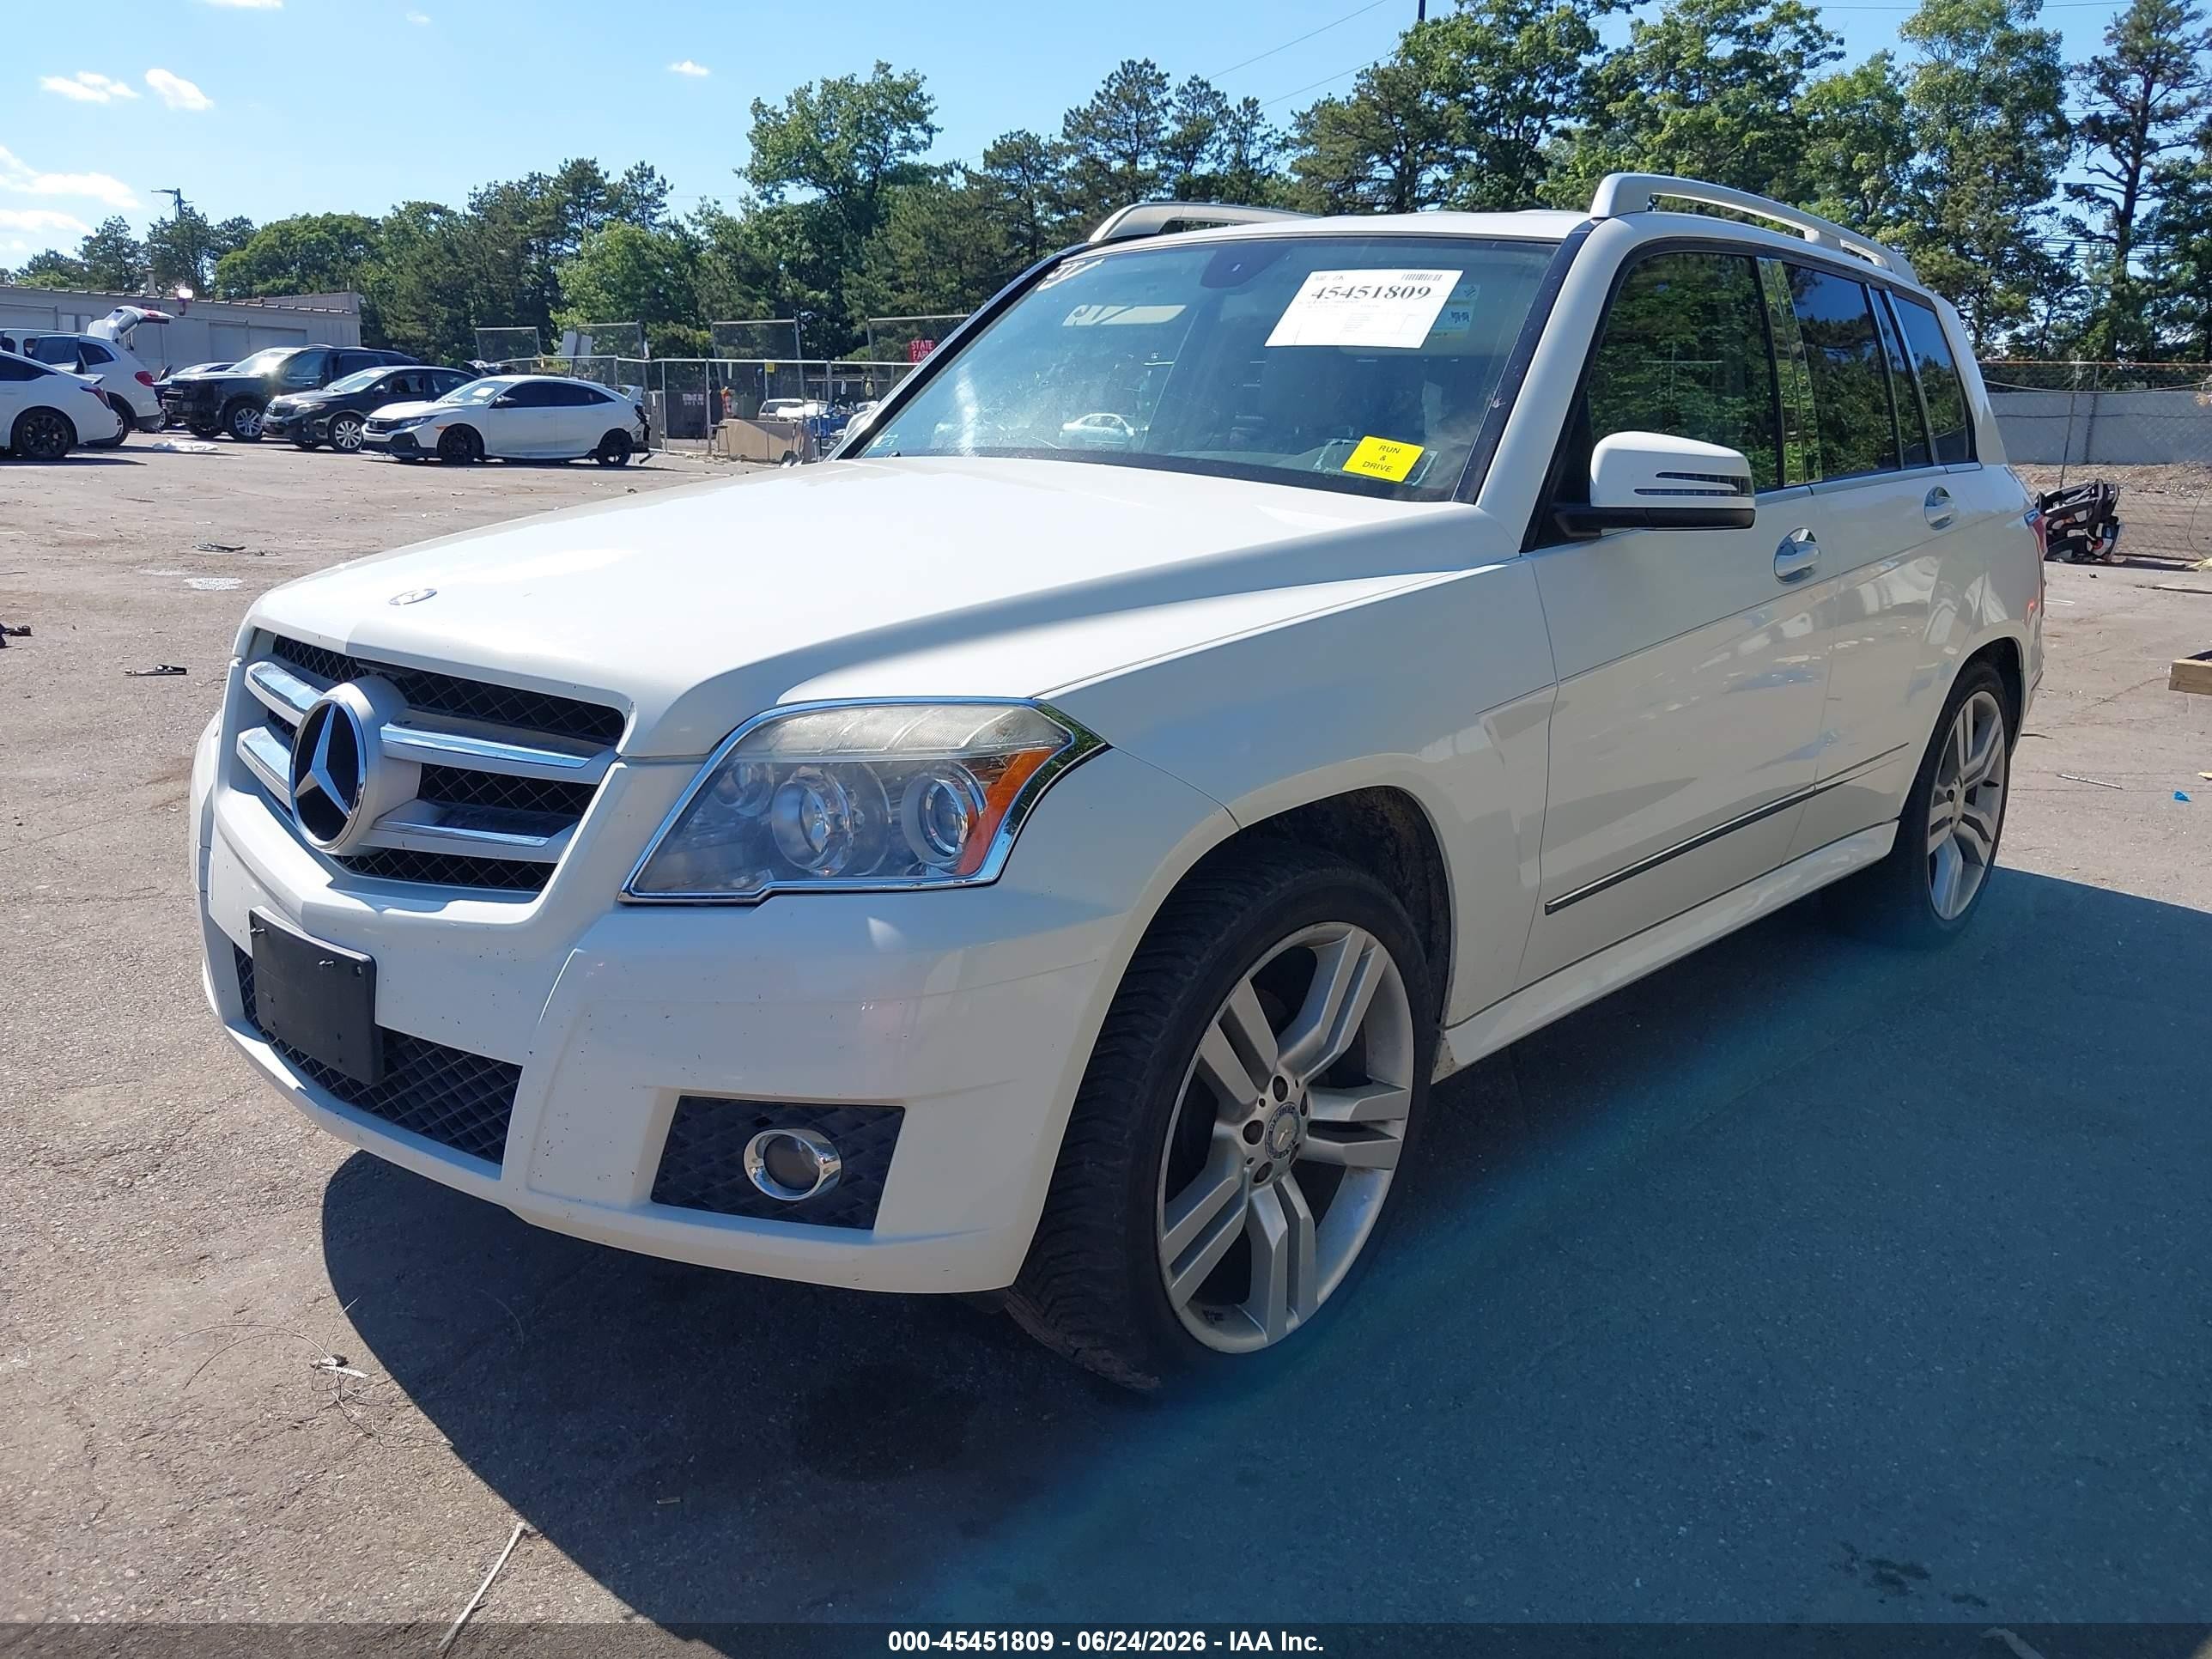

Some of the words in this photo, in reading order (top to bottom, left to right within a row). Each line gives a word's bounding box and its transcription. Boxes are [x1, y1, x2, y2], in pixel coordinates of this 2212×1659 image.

[1311, 284, 1432, 300] 45451809
[911, 339, 933, 349] STATE
[913, 349, 931, 360] FAR
[1378, 444, 1401, 454] RUN
[1362, 460, 1394, 472] DRIVE
